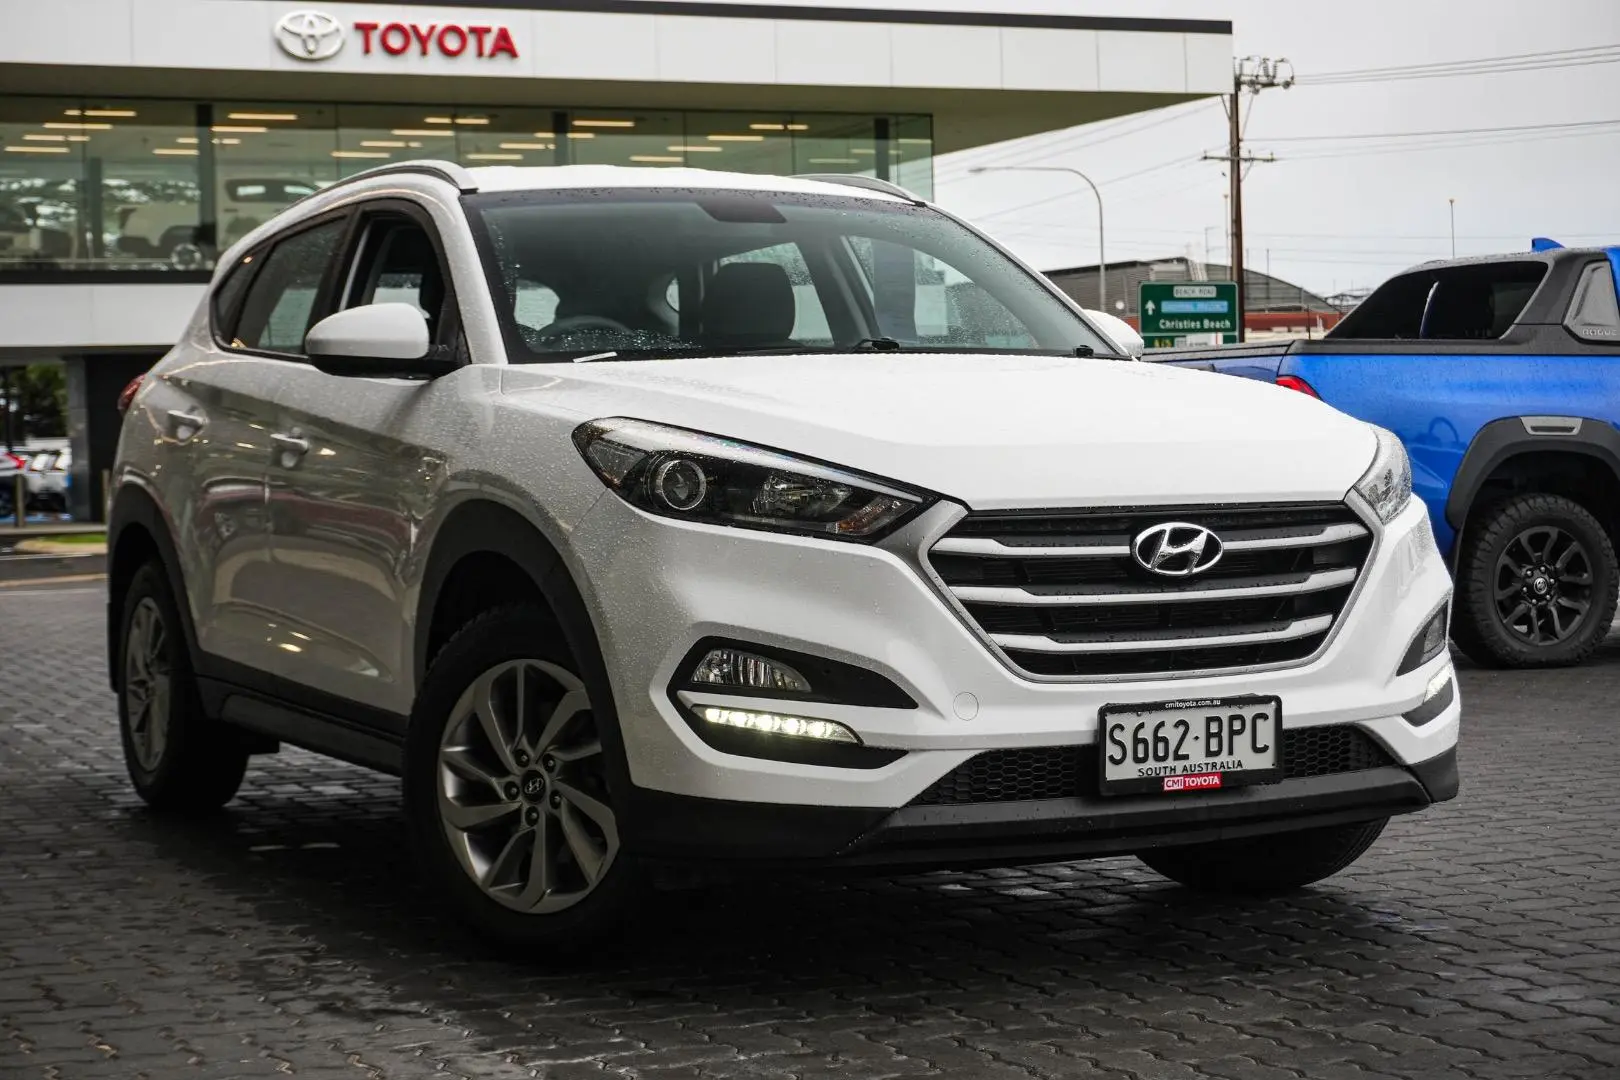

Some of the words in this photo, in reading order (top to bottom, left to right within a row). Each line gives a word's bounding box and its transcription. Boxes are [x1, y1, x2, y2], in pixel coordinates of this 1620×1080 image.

[354, 22, 519, 58] TOYOTA
[1159, 319, 1201, 329] Christies
[1203, 319, 1231, 329] Beach
[1165, 699, 1221, 709] cmitoyota.com.au
[1138, 765, 1177, 777] SOUTH
[1182, 759, 1243, 773] AUSTRALIA
[1165, 778, 1183, 789] CMI
[1185, 775, 1220, 787] TOYOTA
